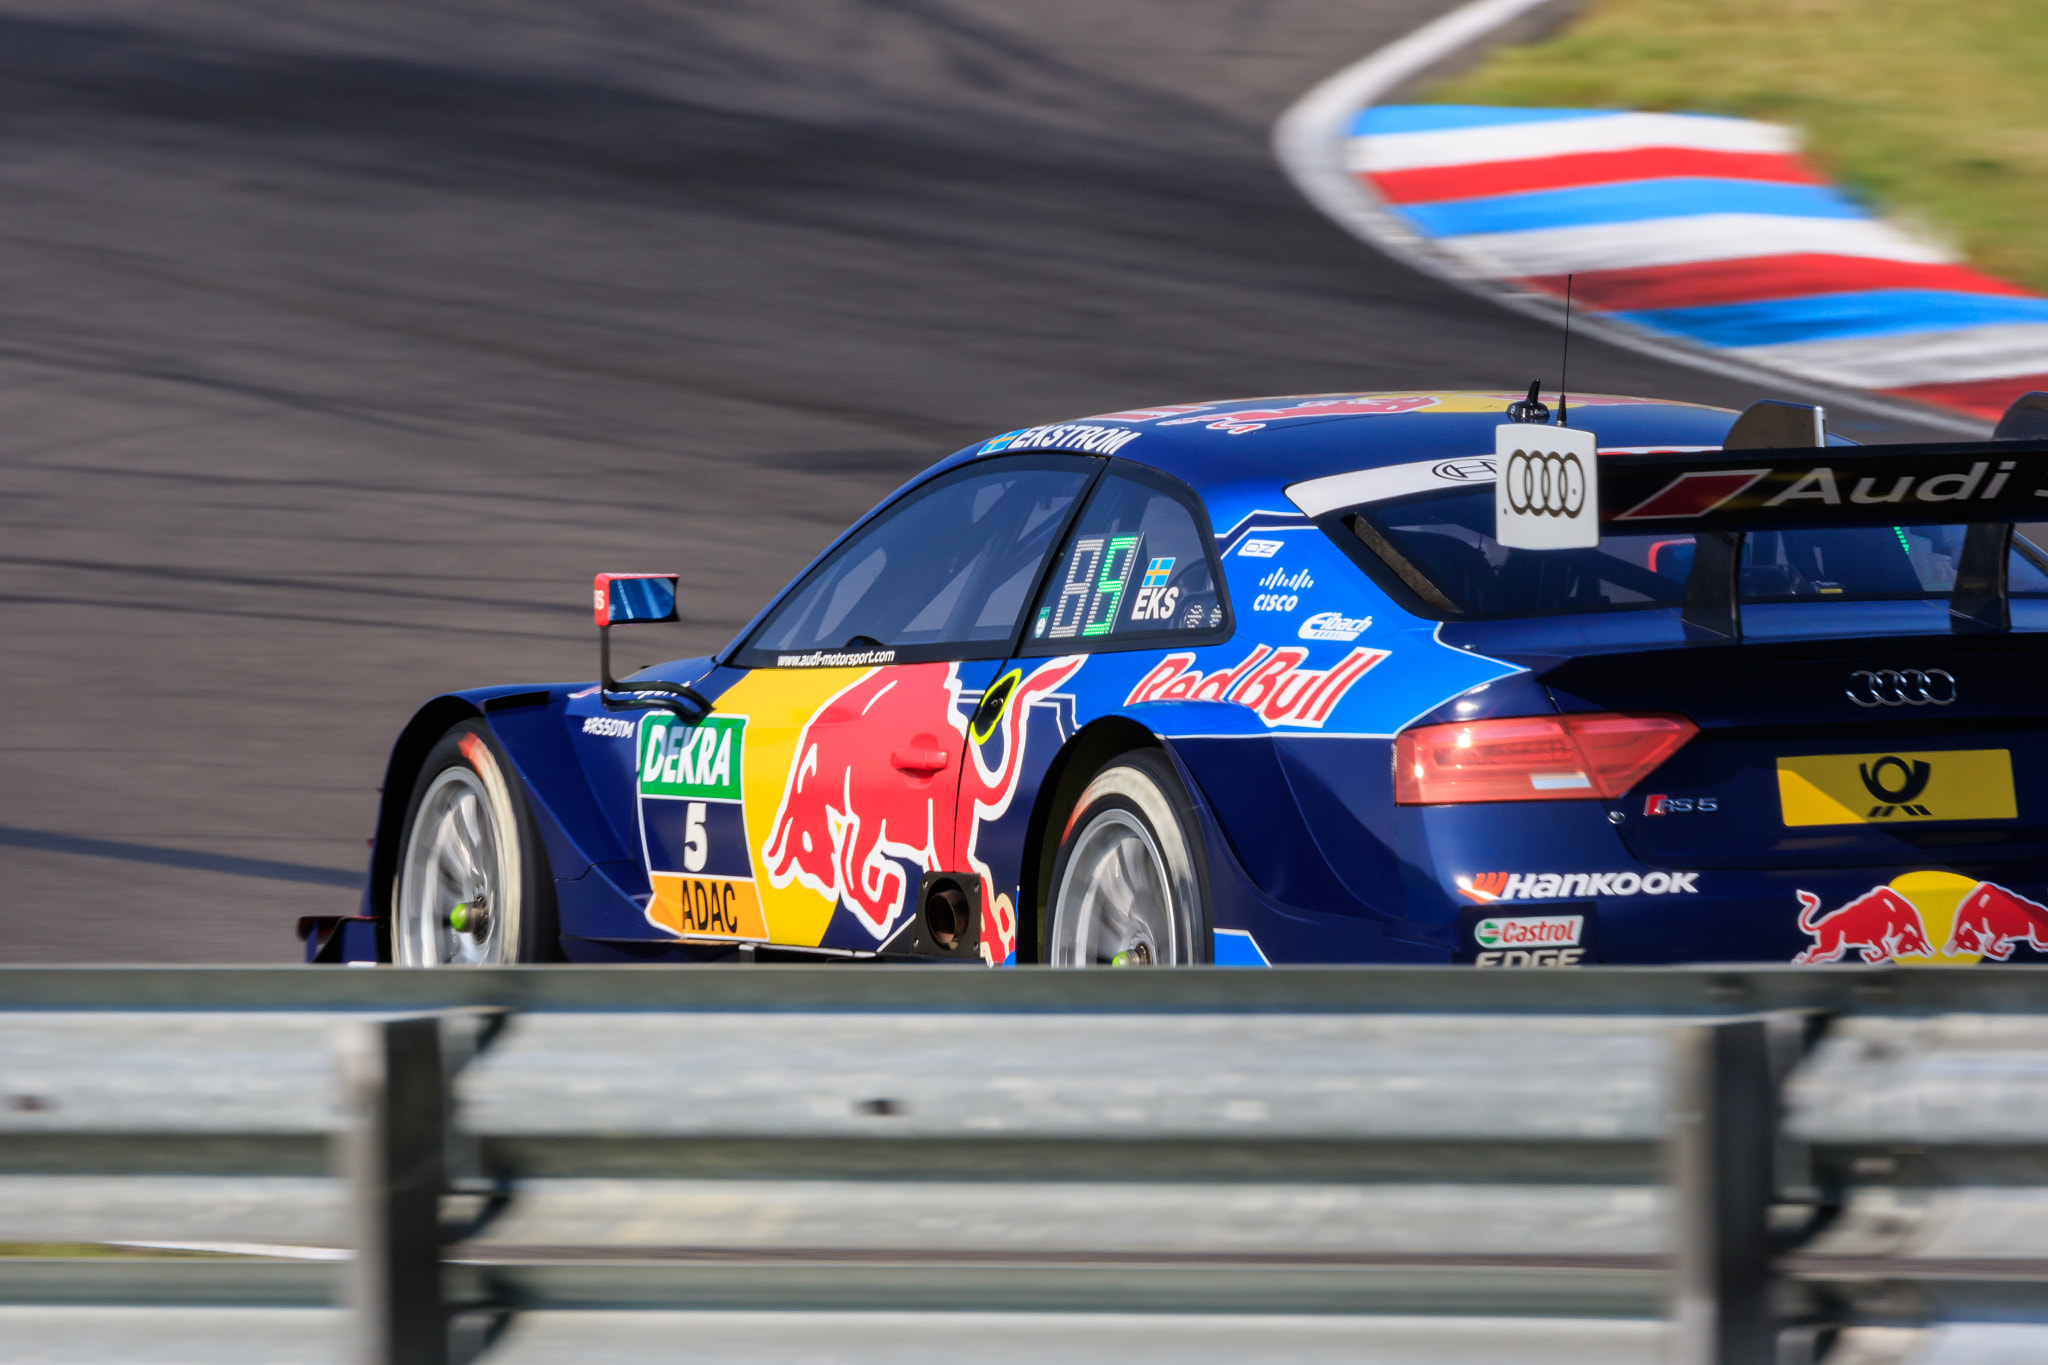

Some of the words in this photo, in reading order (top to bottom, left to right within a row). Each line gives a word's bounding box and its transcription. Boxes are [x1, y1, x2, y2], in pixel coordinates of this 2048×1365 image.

[1761, 461, 2017, 506] Audi
[1131, 587, 1179, 620] EKS
[777, 650, 896, 667] www.audi-motorsport.com
[642, 724, 732, 786] DEKRA
[683, 802, 708, 872] 5
[682, 880, 738, 934] ADAC
[1502, 920, 1575, 943] Castrol
